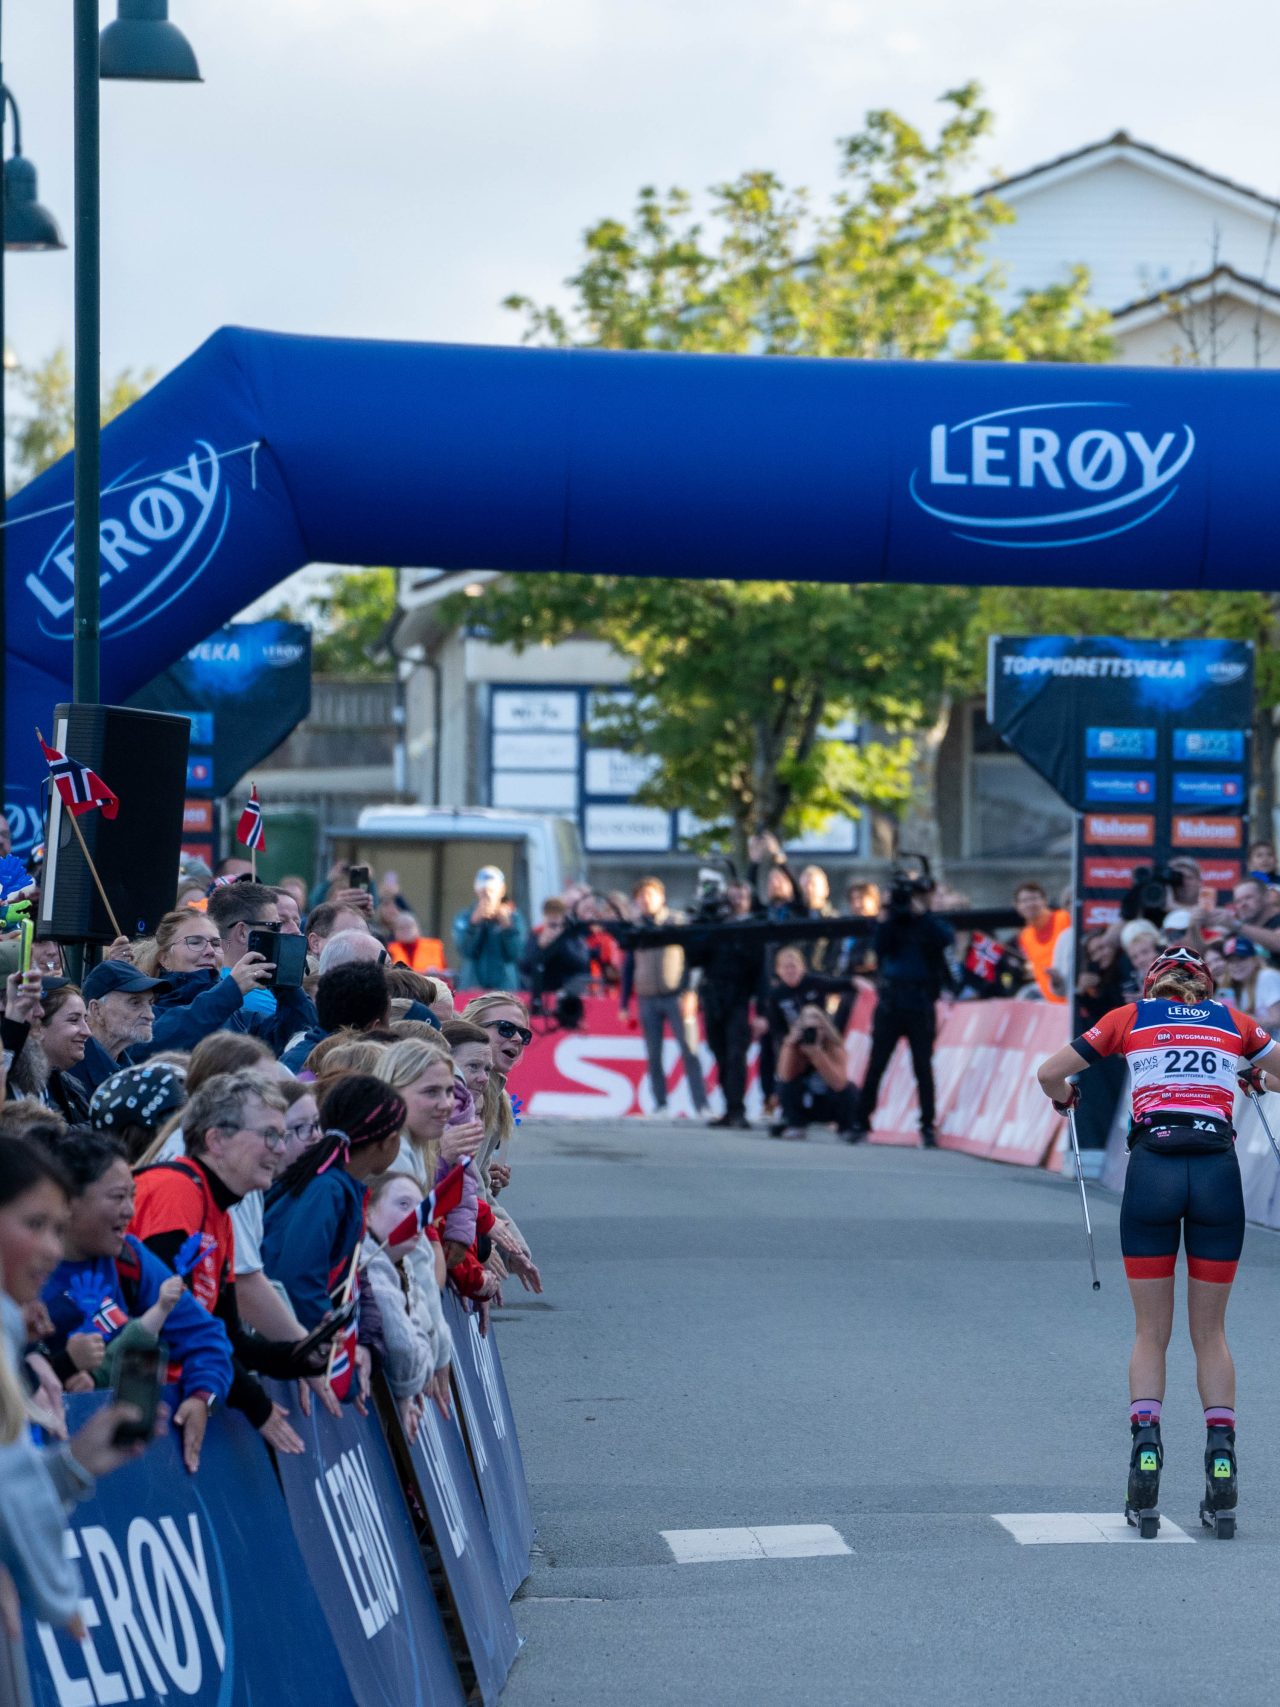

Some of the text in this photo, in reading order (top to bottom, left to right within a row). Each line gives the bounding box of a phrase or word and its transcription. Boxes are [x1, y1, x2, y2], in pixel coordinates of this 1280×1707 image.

[930, 424, 1175, 491] LERØY
[25, 453, 212, 620] LERØY
[1002, 655, 1187, 679] TOPPIDRETTSVEKA
[1168, 1007, 1208, 1017] LERØY
[1157, 1033, 1221, 1043] BM BYGGMAKKER
[1164, 1050, 1217, 1074] 226
